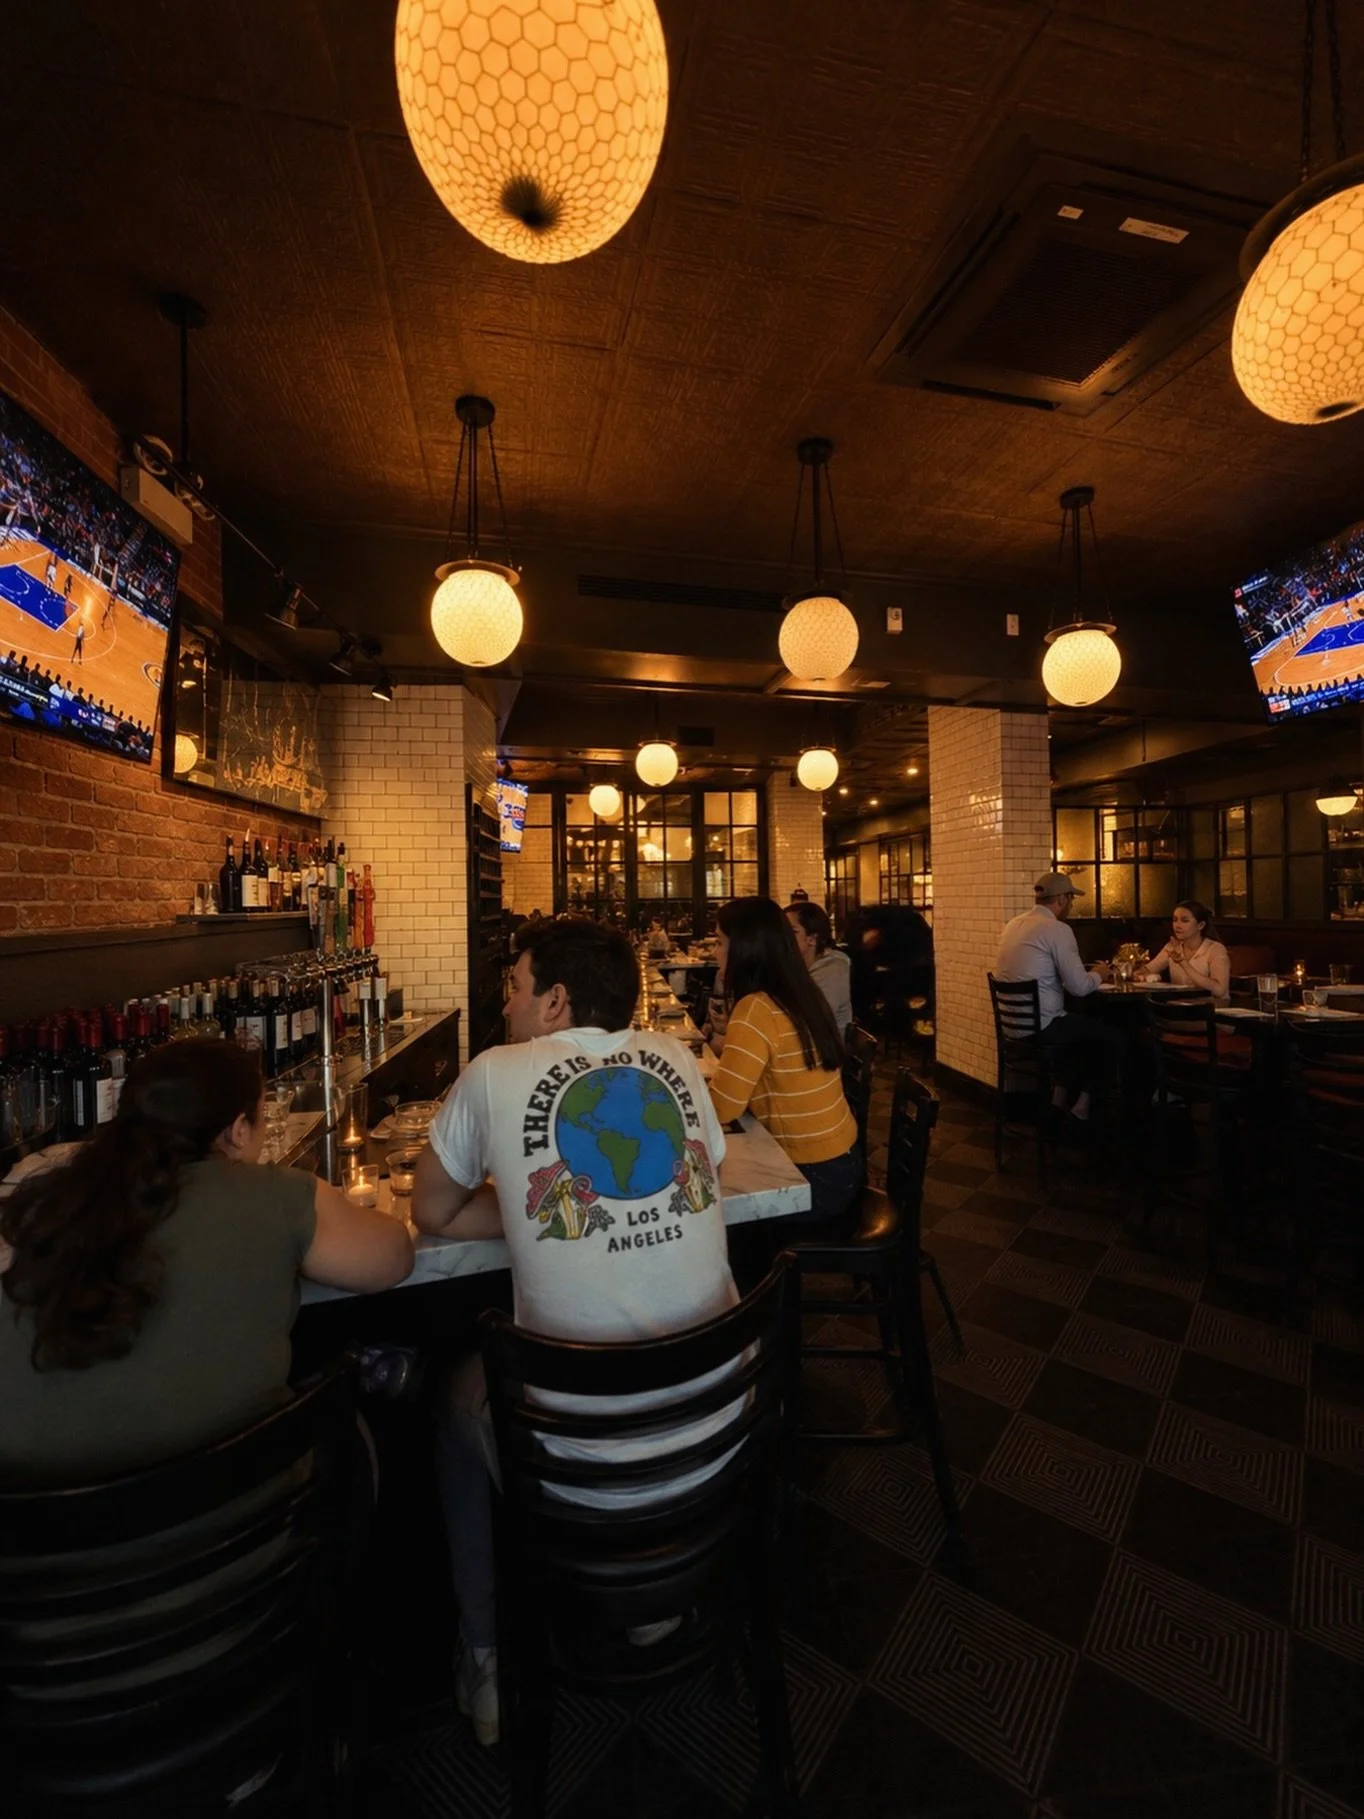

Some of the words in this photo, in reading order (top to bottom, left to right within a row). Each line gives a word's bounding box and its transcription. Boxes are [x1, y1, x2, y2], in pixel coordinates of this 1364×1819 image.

[523, 1063, 570, 1157] THERE
[565, 1056, 592, 1075] IS
[637, 1050, 700, 1128] WHERE
[627, 1208, 660, 1226] LOS
[607, 1224, 683, 1252] ANGELES
